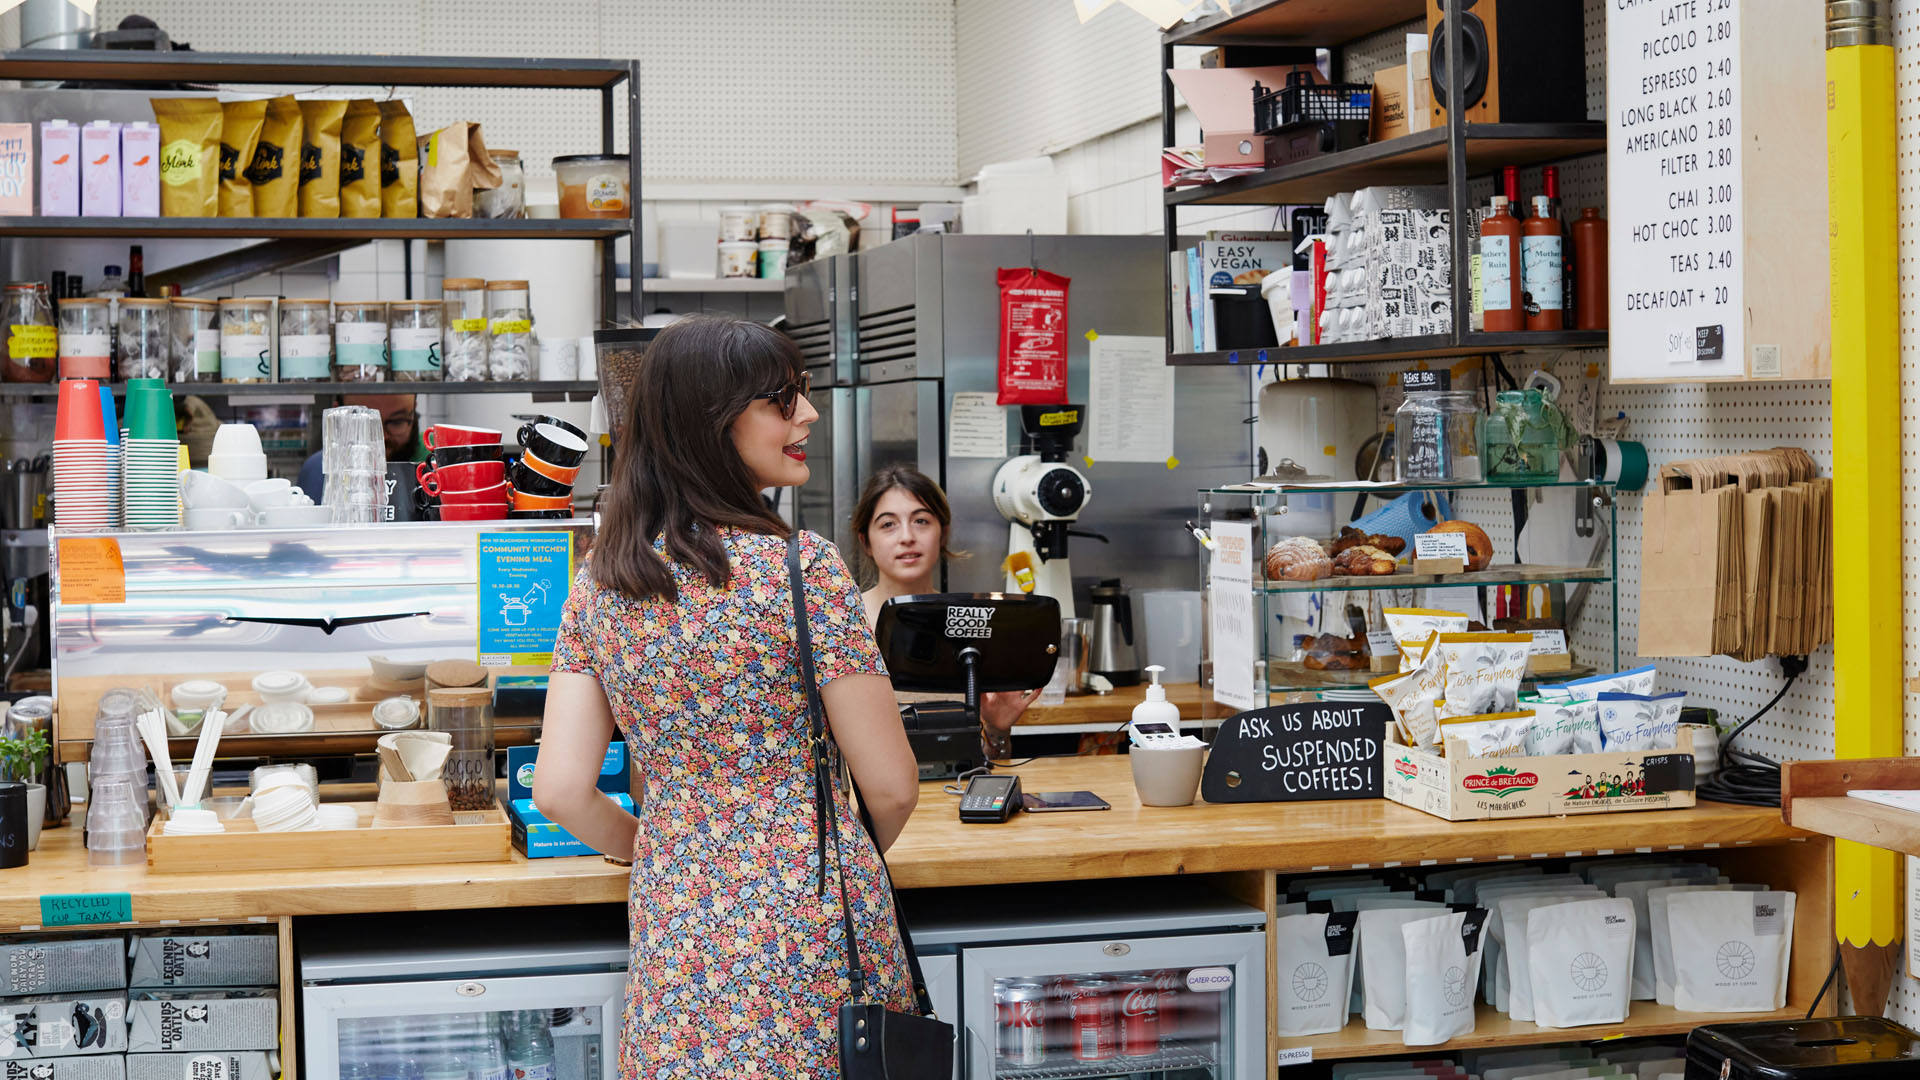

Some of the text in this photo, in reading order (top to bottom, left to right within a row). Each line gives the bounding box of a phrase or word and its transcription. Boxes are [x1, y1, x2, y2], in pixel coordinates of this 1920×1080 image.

[1661, 0, 1697, 26] LATTE
[1643, 20, 1731, 60] PICCOLO 2.80
[1642, 57, 1731, 95] ESPRESSO 2.40
[1621, 87, 1732, 127] LONG BLACK 2.60
[1626, 117, 1732, 154] AMERICANO 2.80
[1661, 147, 1732, 177] FILTER 2.80
[1669, 184, 1732, 210] CHAI 3.00
[1633, 214, 1732, 243] HOT CHOC 3.00
[1210, 258, 1262, 269] VEGAN
[1217, 246, 1255, 257] EASY
[1670, 250, 1732, 273] TEAS 2.40
[1627, 288, 1694, 311] DECAF/OAT
[1715, 286, 1728, 305] 20
[1403, 372, 1420, 384] PLEASE
[533, 545, 566, 553] KITCHEN
[946, 617, 987, 628] GOOD
[947, 606, 995, 619] REALLY
[945, 627, 992, 638] COFFEE
[1448, 666, 1524, 688] Two Farmers
[1239, 708, 1365, 739] ASK US ABOUT
[1530, 722, 1554, 744] Two
[1607, 720, 1679, 746] Two Farmers
[1261, 738, 1377, 771] SUSPENDED
[1645, 757, 1669, 767] CRISPS
[1283, 766, 1373, 793] COFFEES!
[1464, 776, 1536, 788] PRINCE de BRETAGNE
[1477, 801, 1488, 810] LES
[51, 896, 110, 911] RECYCLED
[51, 911, 112, 924] CUP TRAYS
[163, 938, 174, 986] LEGENDS
[174, 943, 185, 977] OATLY
[161, 1001, 172, 1051] LEGENDS
[172, 1006, 183, 1042] OATLY
[1279, 1051, 1310, 1061] ESPRESSO
